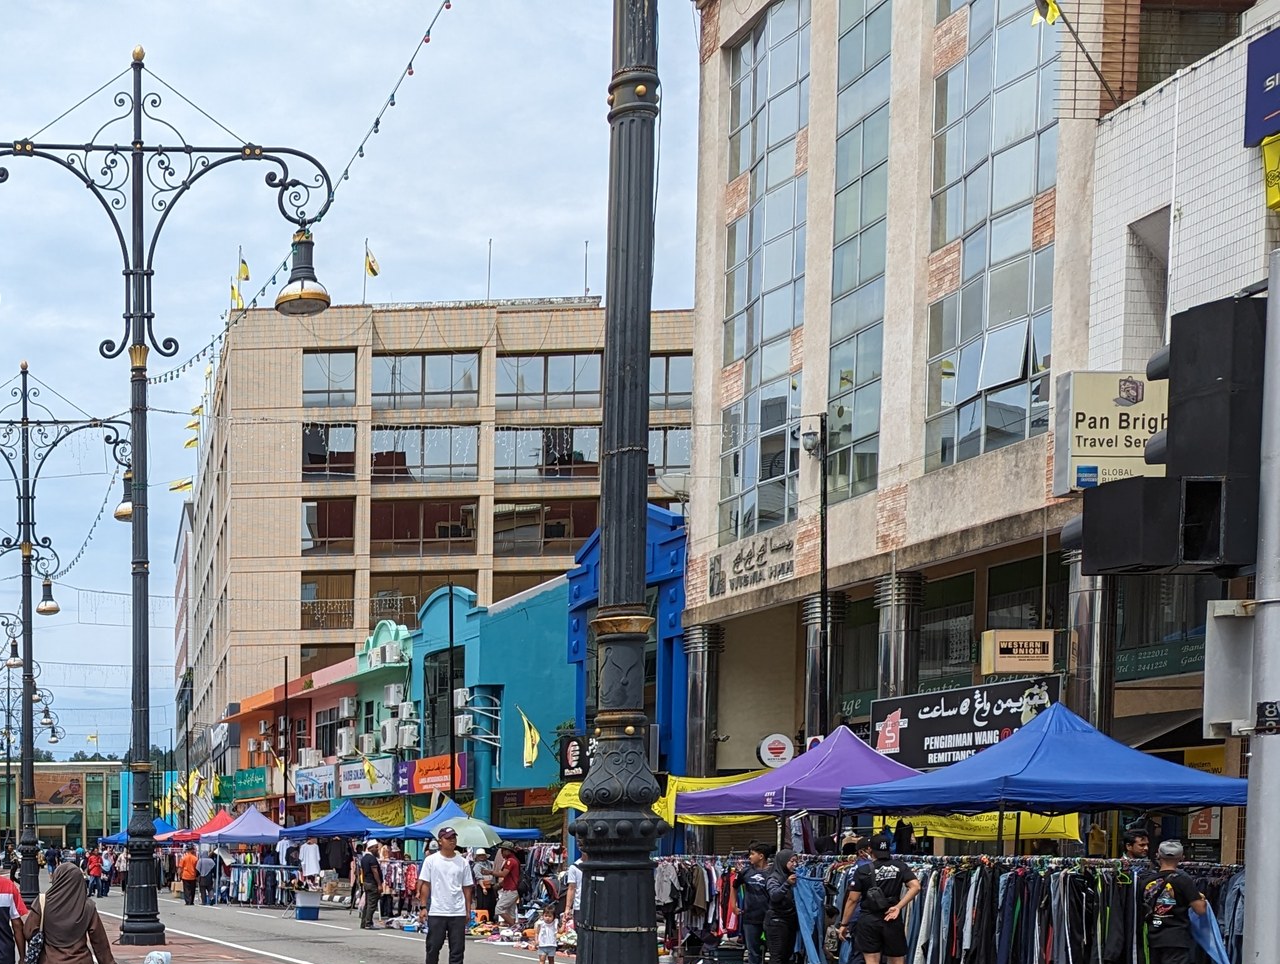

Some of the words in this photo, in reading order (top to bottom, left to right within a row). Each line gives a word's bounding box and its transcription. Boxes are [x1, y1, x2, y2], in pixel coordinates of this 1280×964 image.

[1075, 412, 1110, 430] Pan
[1075, 435, 1118, 448] Travel
[1102, 468, 1134, 476] GLOBAL
[1000, 641, 1041, 649] WESTERN
[1138, 649, 1169, 660] 2222012
[924, 732, 973, 751] PENGIRIMAN
[974, 729, 1000, 746] WANG
